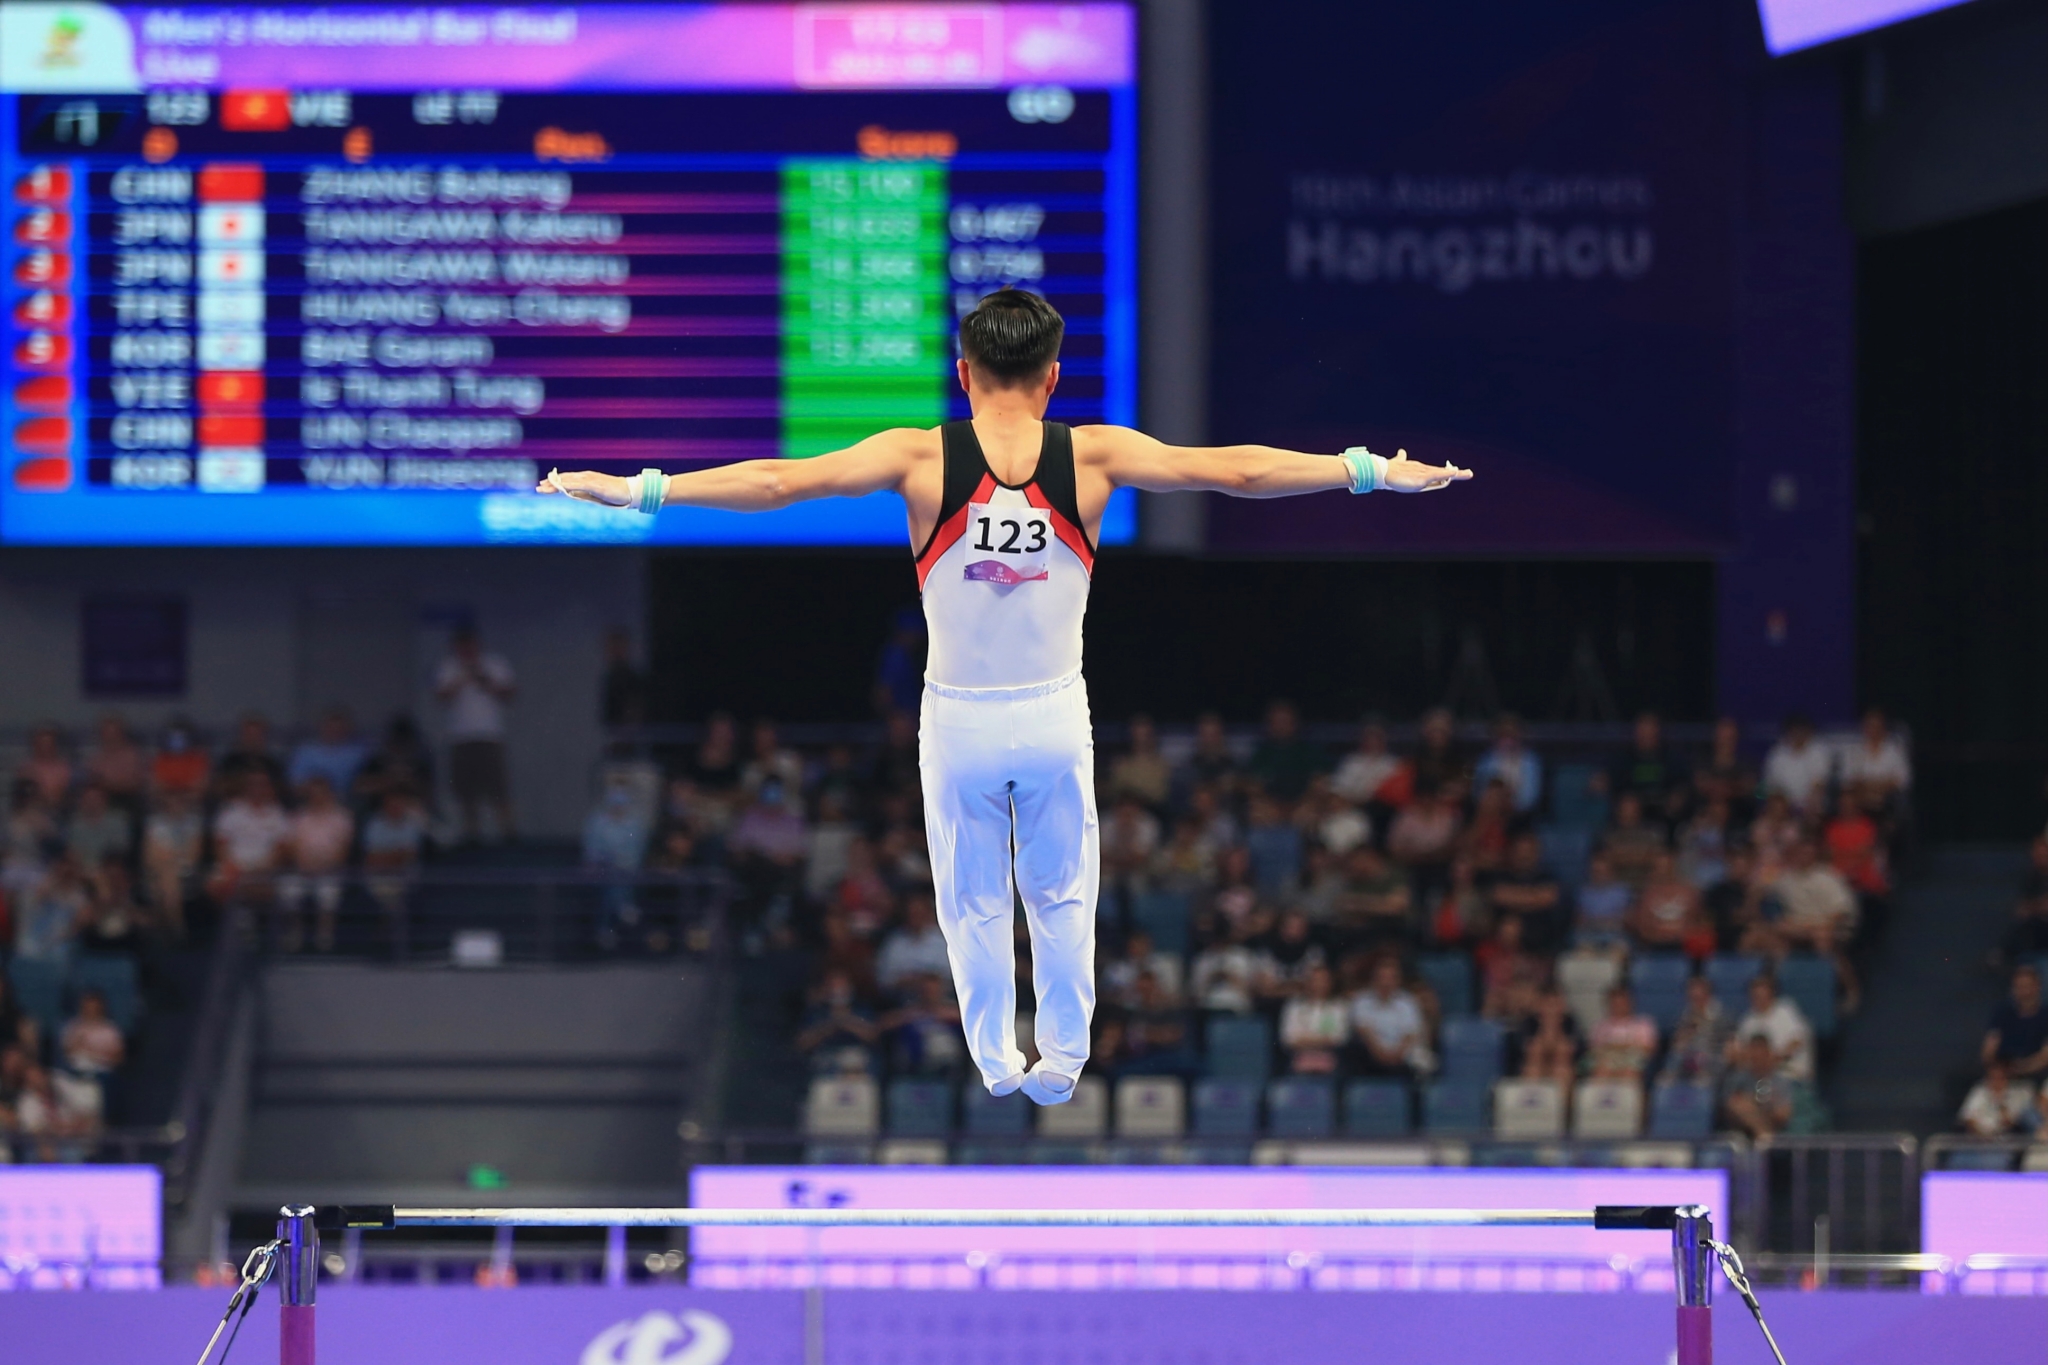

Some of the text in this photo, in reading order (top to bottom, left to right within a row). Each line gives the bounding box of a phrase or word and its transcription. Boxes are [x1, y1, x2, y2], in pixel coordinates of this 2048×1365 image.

[250, 12, 426, 44] Horizontal
[427, 12, 491, 44] Bar
[493, 11, 577, 44] Final
[146, 90, 207, 123] 123
[288, 90, 351, 124] VIE
[858, 128, 956, 160] Score
[112, 168, 191, 201] CHN
[302, 167, 570, 208] ZHANG Boheng
[1384, 173, 1502, 211] Asian
[1506, 173, 1653, 211] Games
[112, 209, 191, 242] JPN
[302, 209, 621, 243] TANIGAWA Kakeru
[112, 250, 191, 283] JPN
[302, 250, 628, 283] TANIGAWA Wataru
[1287, 218, 1652, 290] Hangzhou
[112, 291, 191, 324] TPE
[302, 291, 438, 324] HUANG
[112, 332, 191, 365] KOR
[302, 332, 375, 365] BAE
[112, 373, 191, 406] VIE
[340, 373, 449, 406] Thanh
[112, 414, 191, 447] CHN
[302, 414, 364, 446] LIN
[302, 455, 383, 488] YUN
[974, 517, 1047, 553] 123
